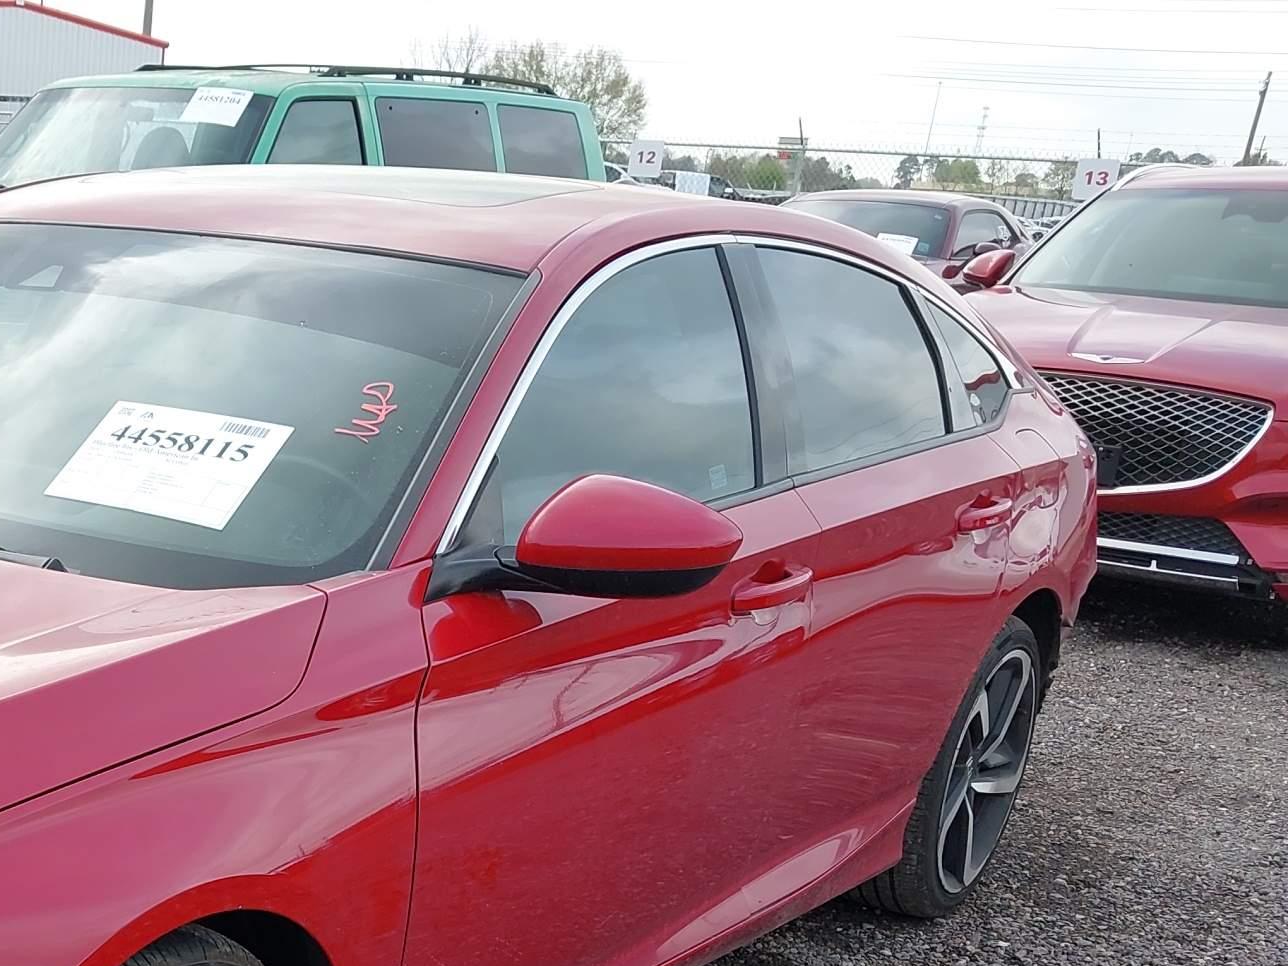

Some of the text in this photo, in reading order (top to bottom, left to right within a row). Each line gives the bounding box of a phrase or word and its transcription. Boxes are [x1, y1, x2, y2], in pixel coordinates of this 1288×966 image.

[637, 150, 656, 164] 12
[1085, 171, 1109, 186] 13
[109, 424, 255, 462] 44558115
